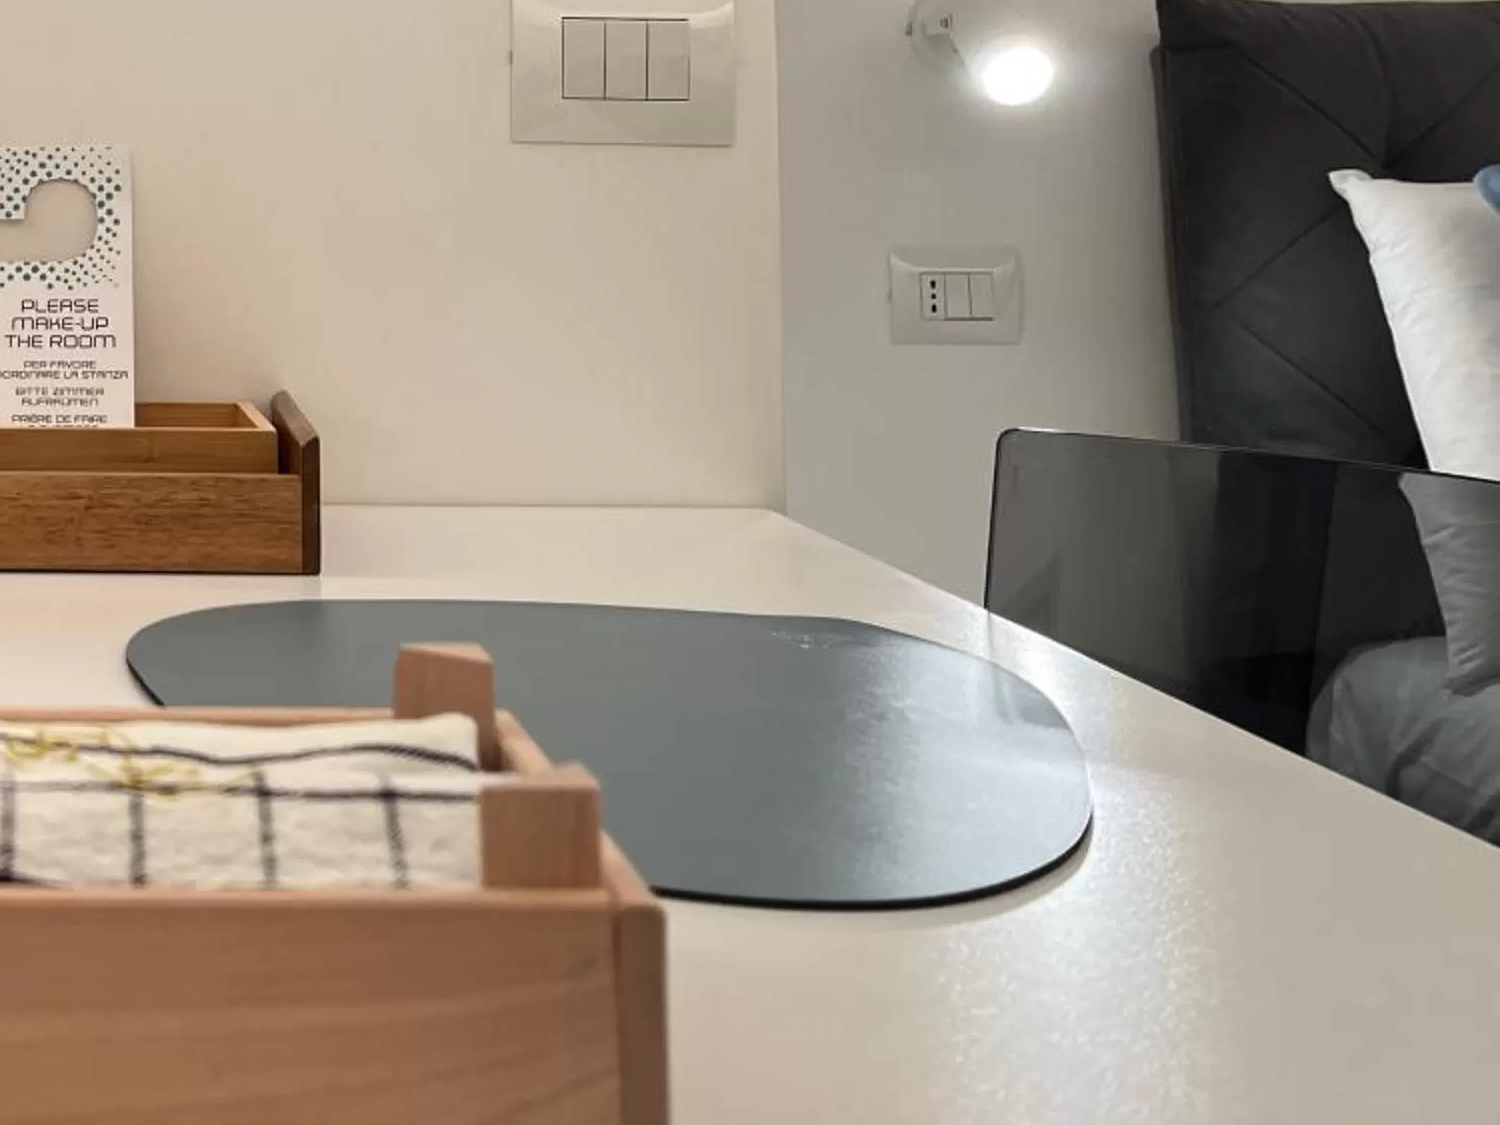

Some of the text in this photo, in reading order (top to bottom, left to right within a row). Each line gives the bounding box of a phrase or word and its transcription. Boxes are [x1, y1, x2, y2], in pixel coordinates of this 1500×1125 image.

[21, 298, 99, 313] PLEASE
[11, 316, 108, 331] MAKE-UP
[4, 334, 116, 348] THE ROOM
